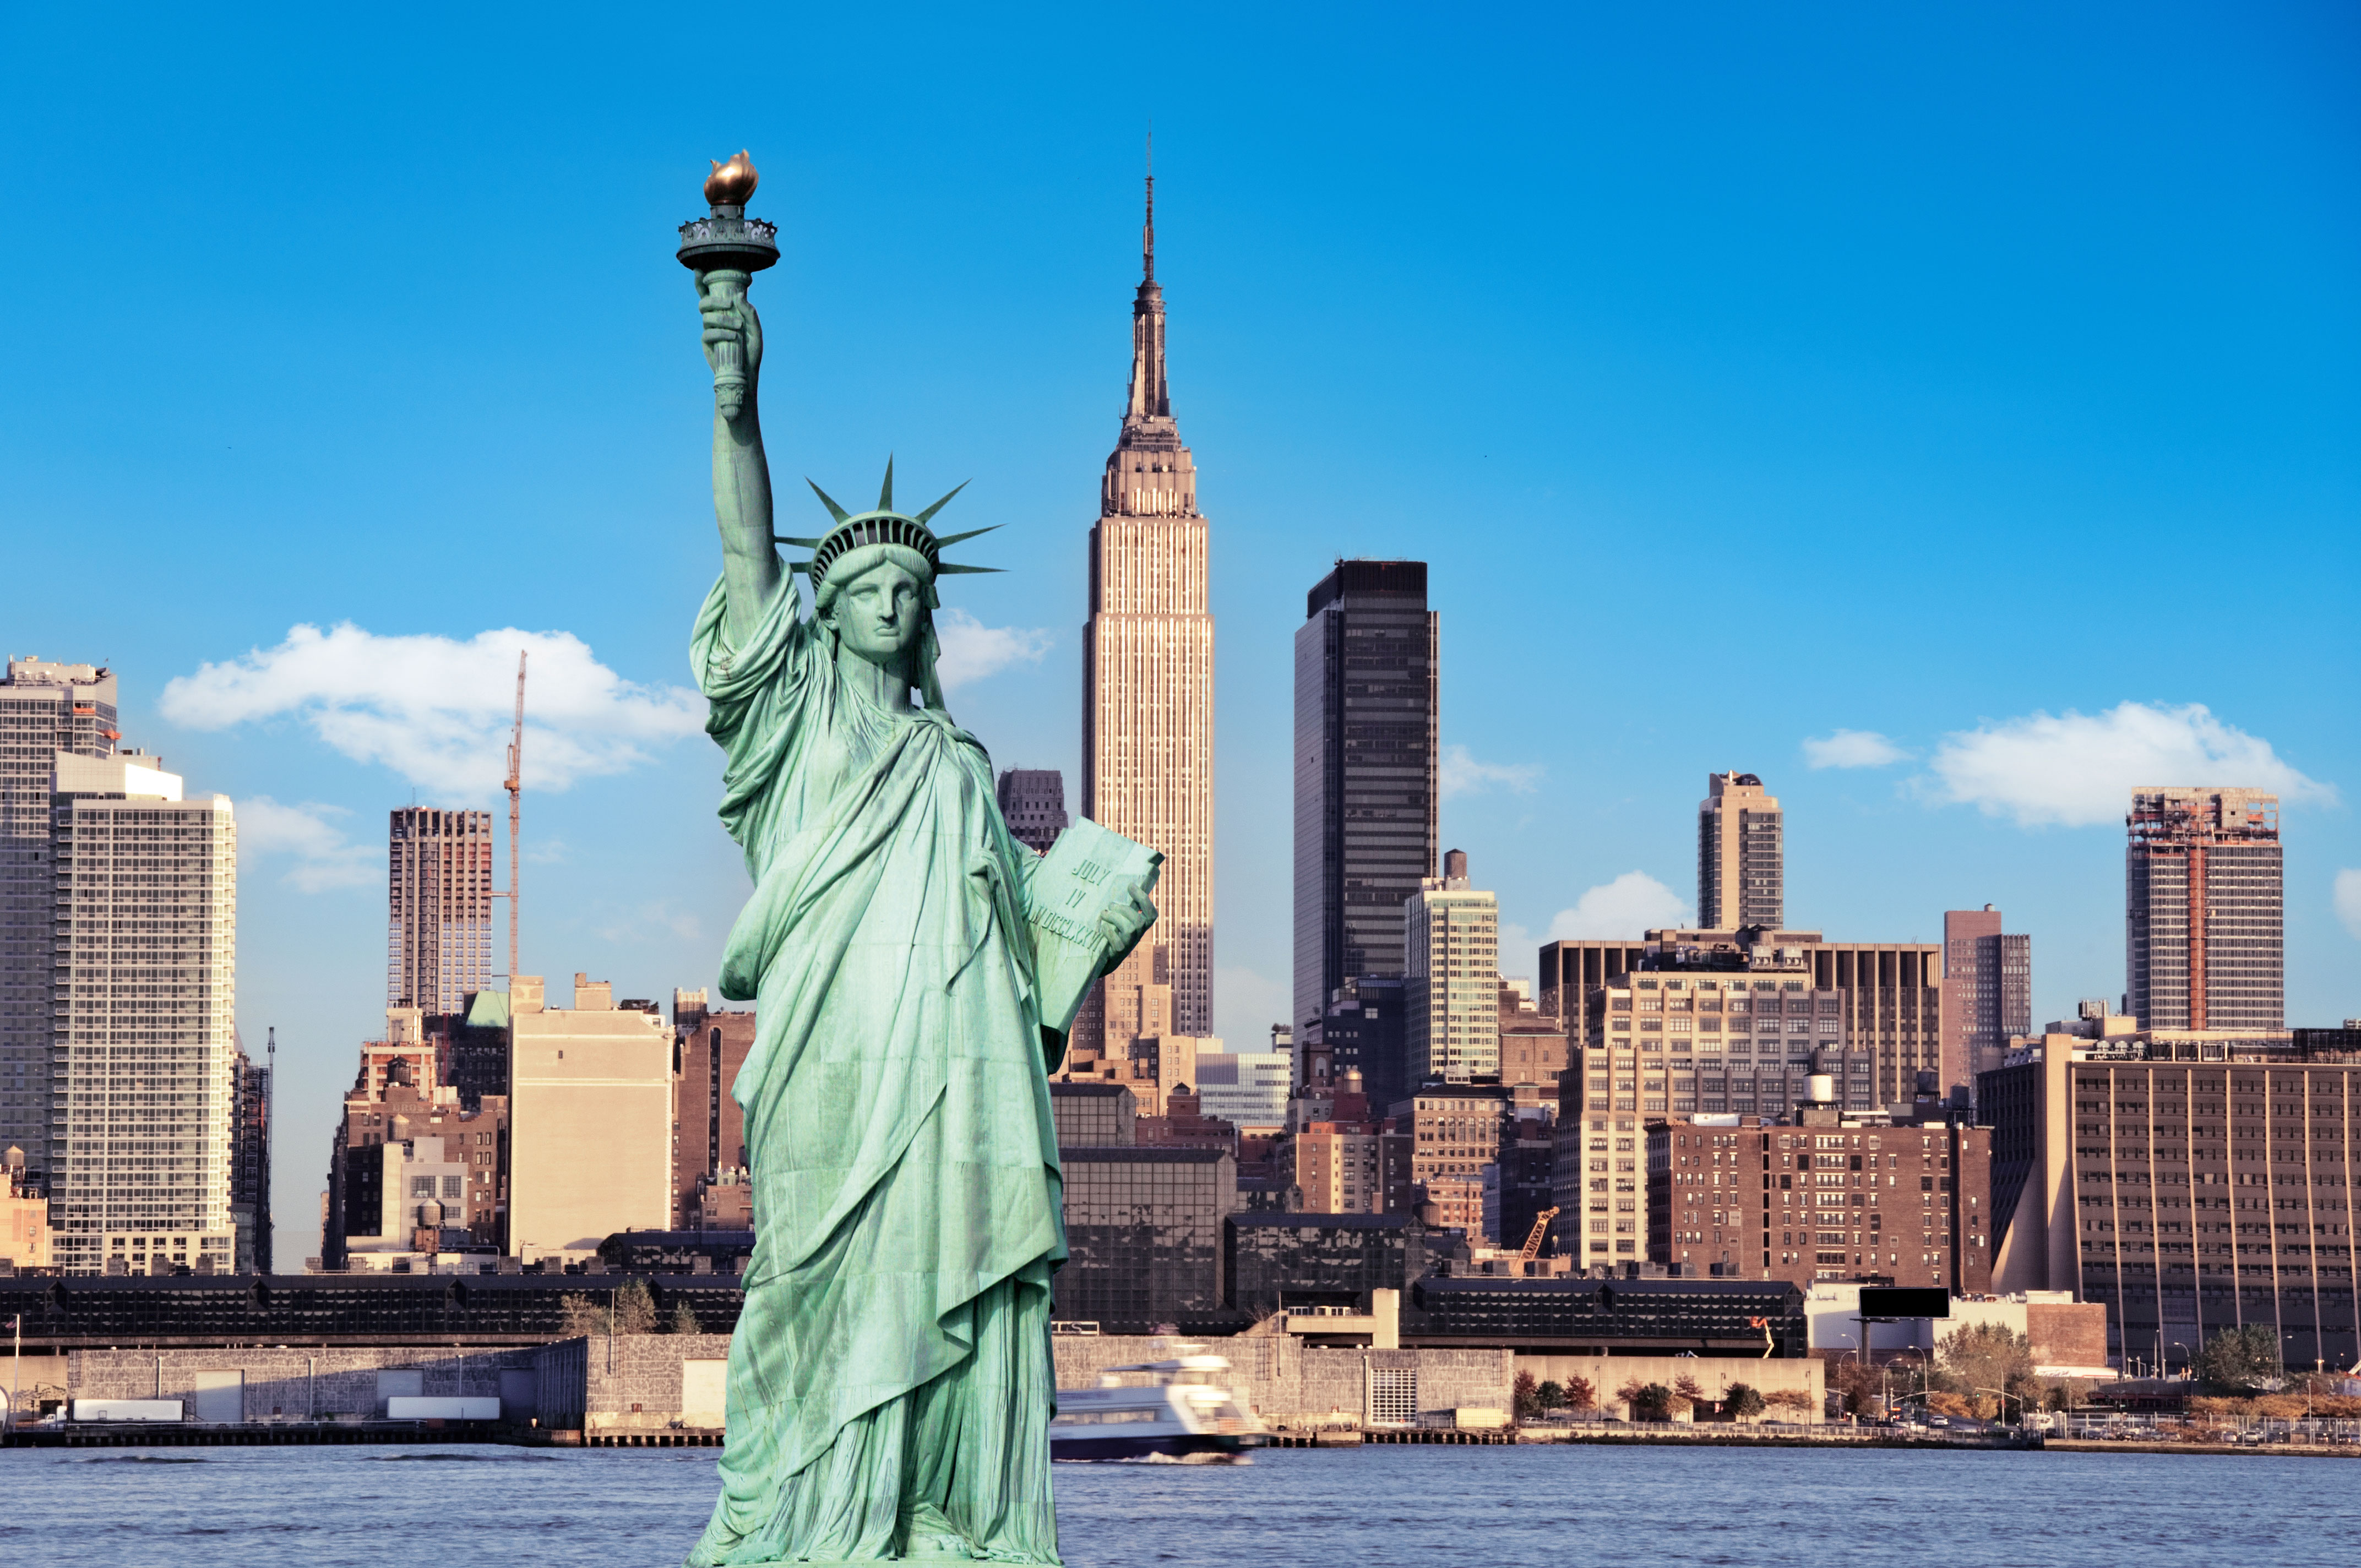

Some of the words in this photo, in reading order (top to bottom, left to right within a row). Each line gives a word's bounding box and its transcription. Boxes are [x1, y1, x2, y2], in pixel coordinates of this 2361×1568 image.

[1071, 859, 1112, 886] JULY
[1065, 888, 1086, 908] IV
[1029, 905, 1105, 952] MDCCLXXVI
